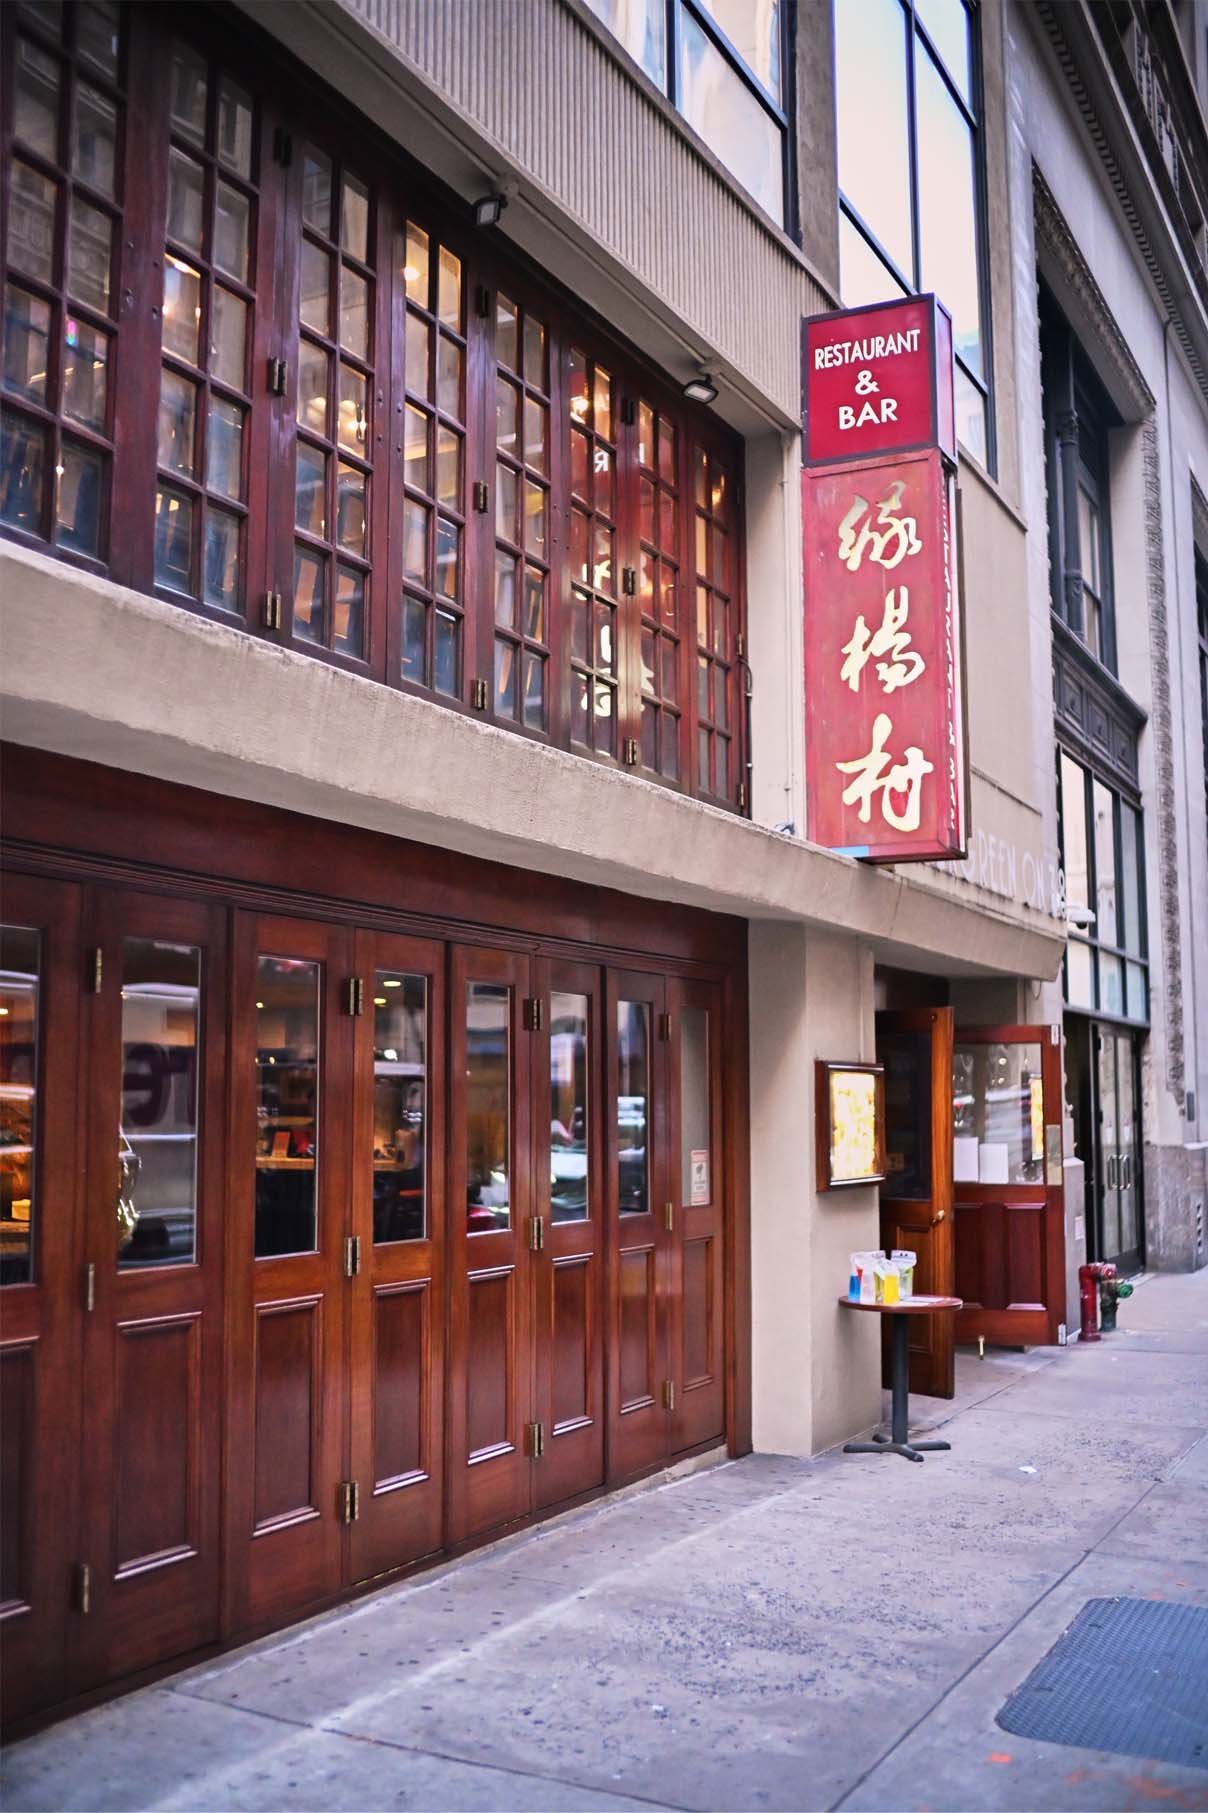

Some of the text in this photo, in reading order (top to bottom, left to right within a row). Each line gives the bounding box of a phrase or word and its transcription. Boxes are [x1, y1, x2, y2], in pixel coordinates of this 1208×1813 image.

[814, 329, 921, 370] RESTAURANT
[855, 370, 880, 395] &
[838, 398, 898, 430] BAR
[1021, 851, 1047, 912] ON
